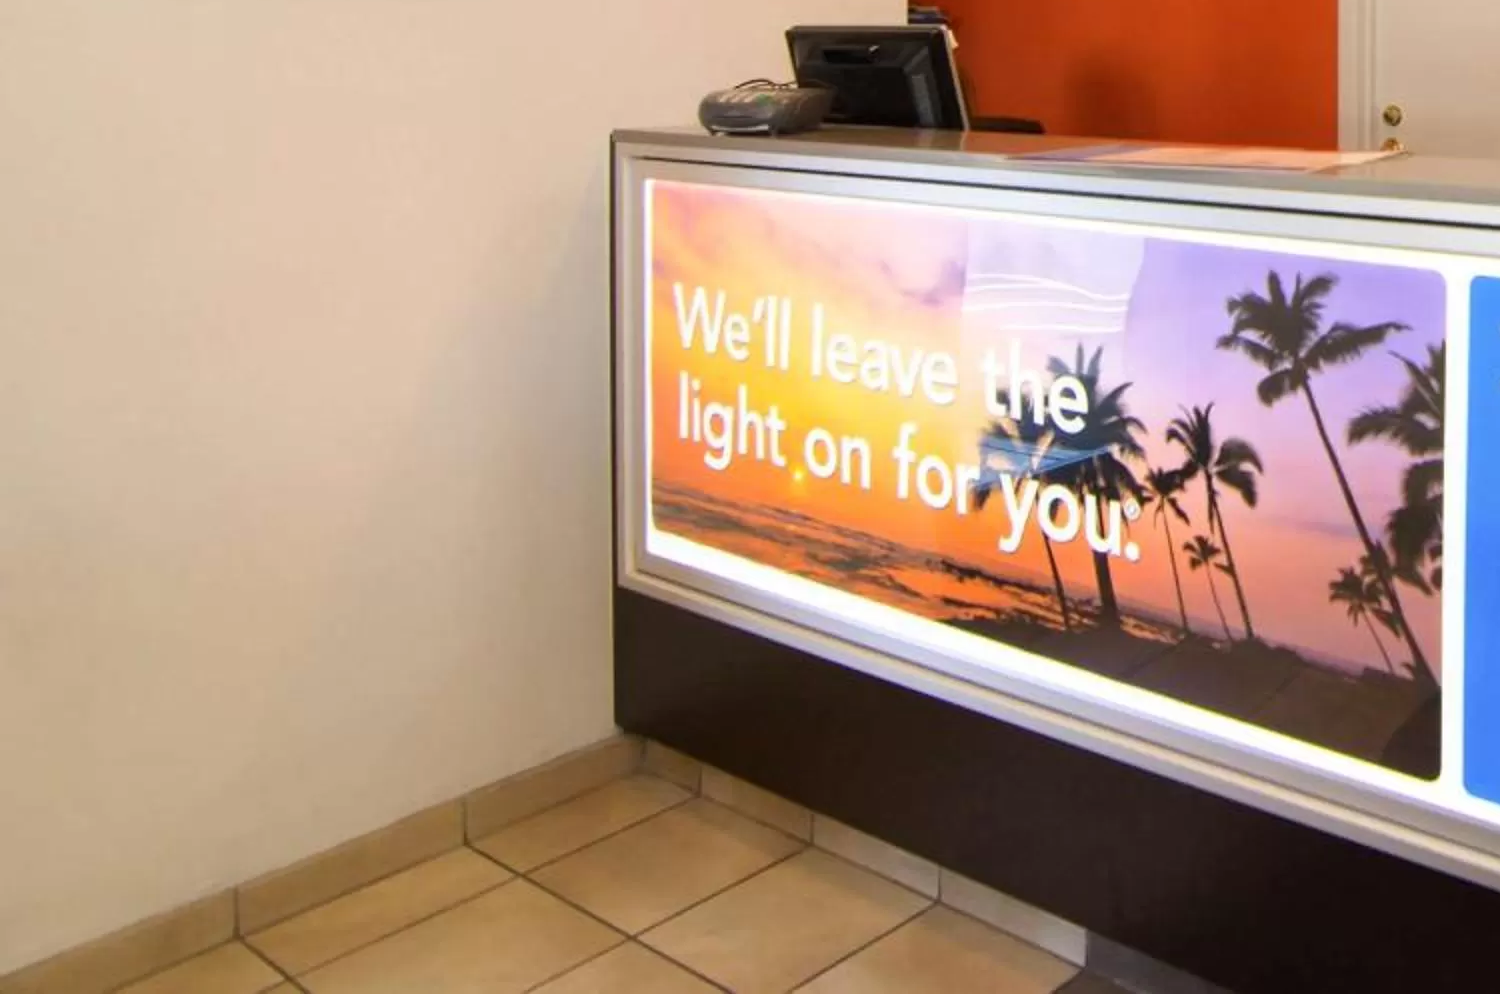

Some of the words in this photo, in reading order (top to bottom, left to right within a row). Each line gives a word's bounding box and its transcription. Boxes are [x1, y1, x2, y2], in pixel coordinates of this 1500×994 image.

[672, 280, 792, 371] We'll
[810, 302, 958, 406] leave
[980, 338, 1090, 434] the
[678, 370, 787, 471] light
[803, 425, 872, 491] on
[891, 421, 984, 515] for
